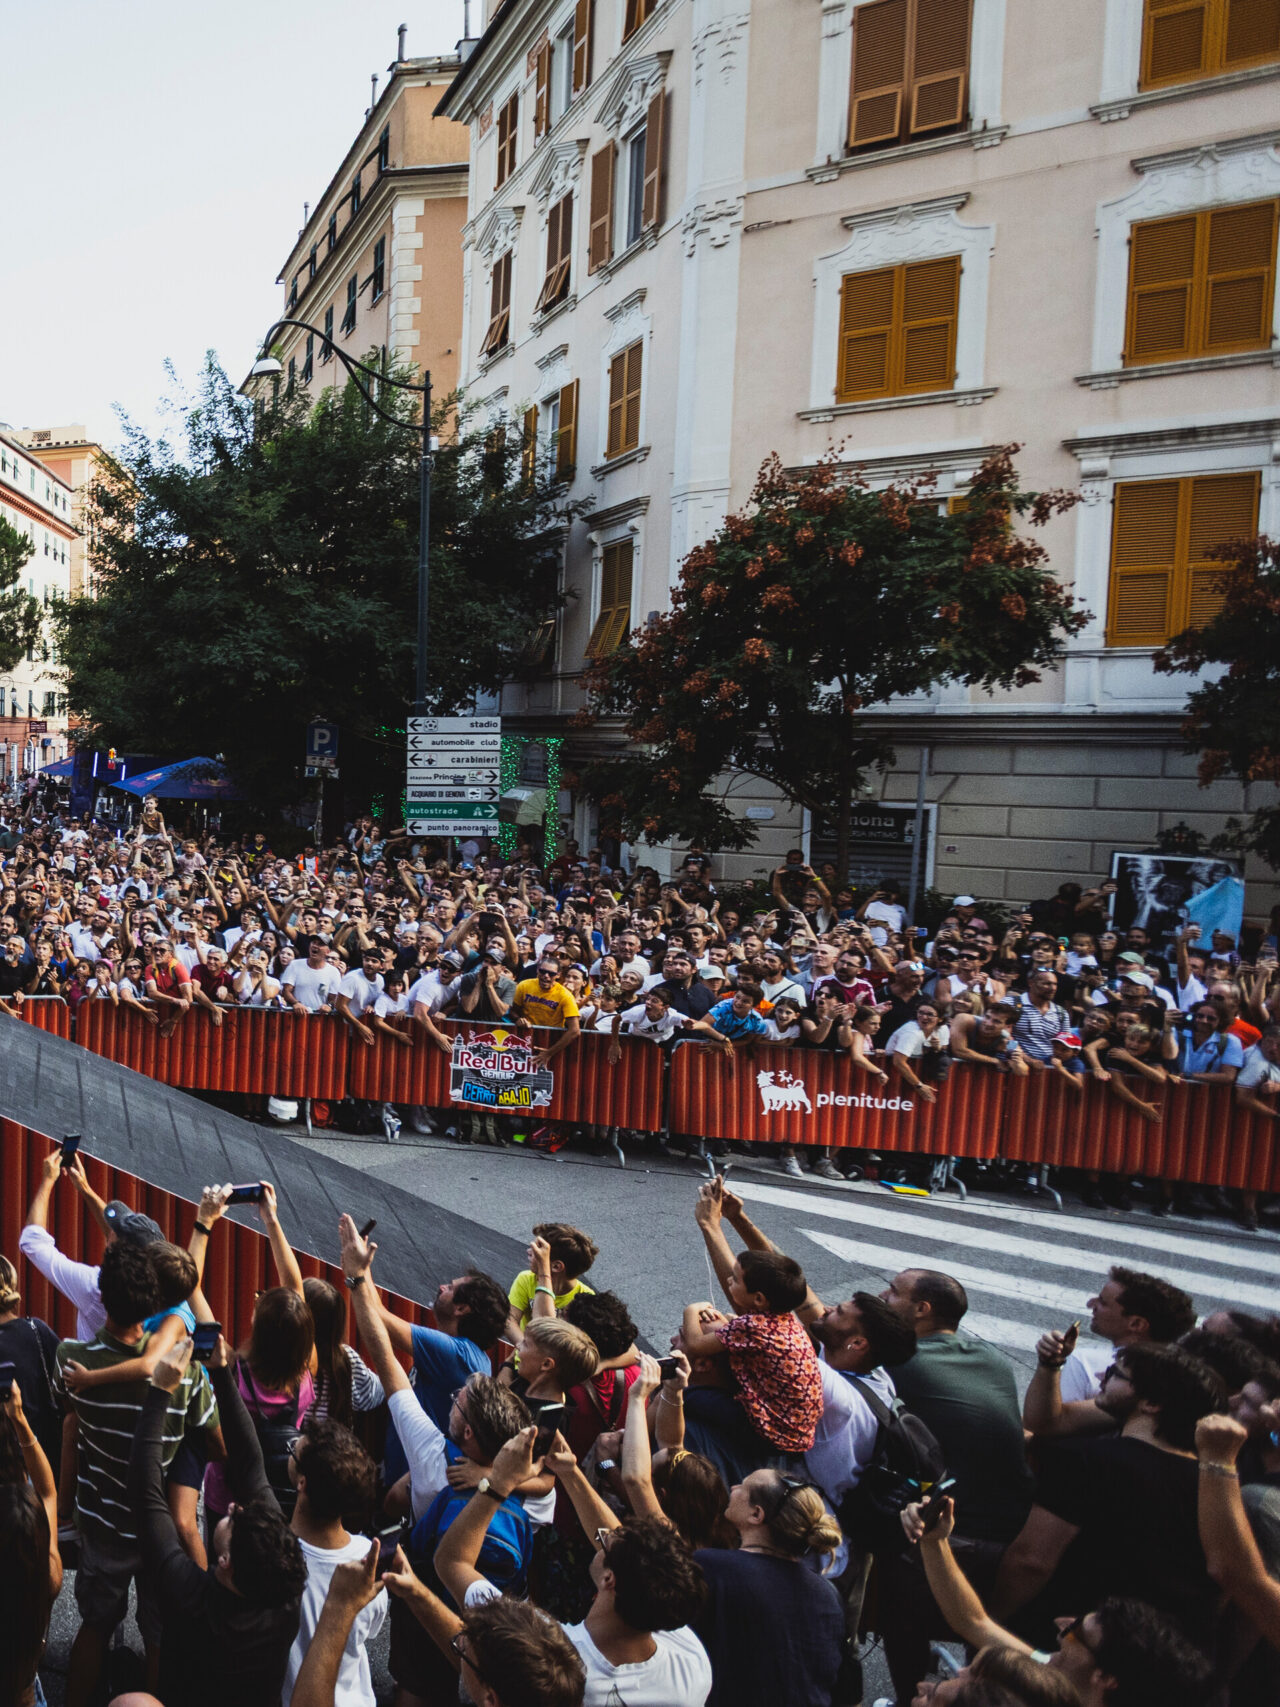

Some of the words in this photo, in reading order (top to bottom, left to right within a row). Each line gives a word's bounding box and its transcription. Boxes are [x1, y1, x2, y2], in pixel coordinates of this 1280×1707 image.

[469, 720, 499, 728] stadio
[313, 728, 331, 751] P
[451, 755, 498, 763] carabinieri
[411, 790, 437, 798] ACQUARIO
[445, 790, 466, 798] GENOVA
[453, 824, 497, 832] panoramico
[460, 1052, 497, 1069] Red
[500, 1055, 537, 1073] Bull
[463, 1082, 496, 1105] CERRO
[498, 1087, 530, 1106] ABAJO
[816, 1090, 914, 1111] plenitude
